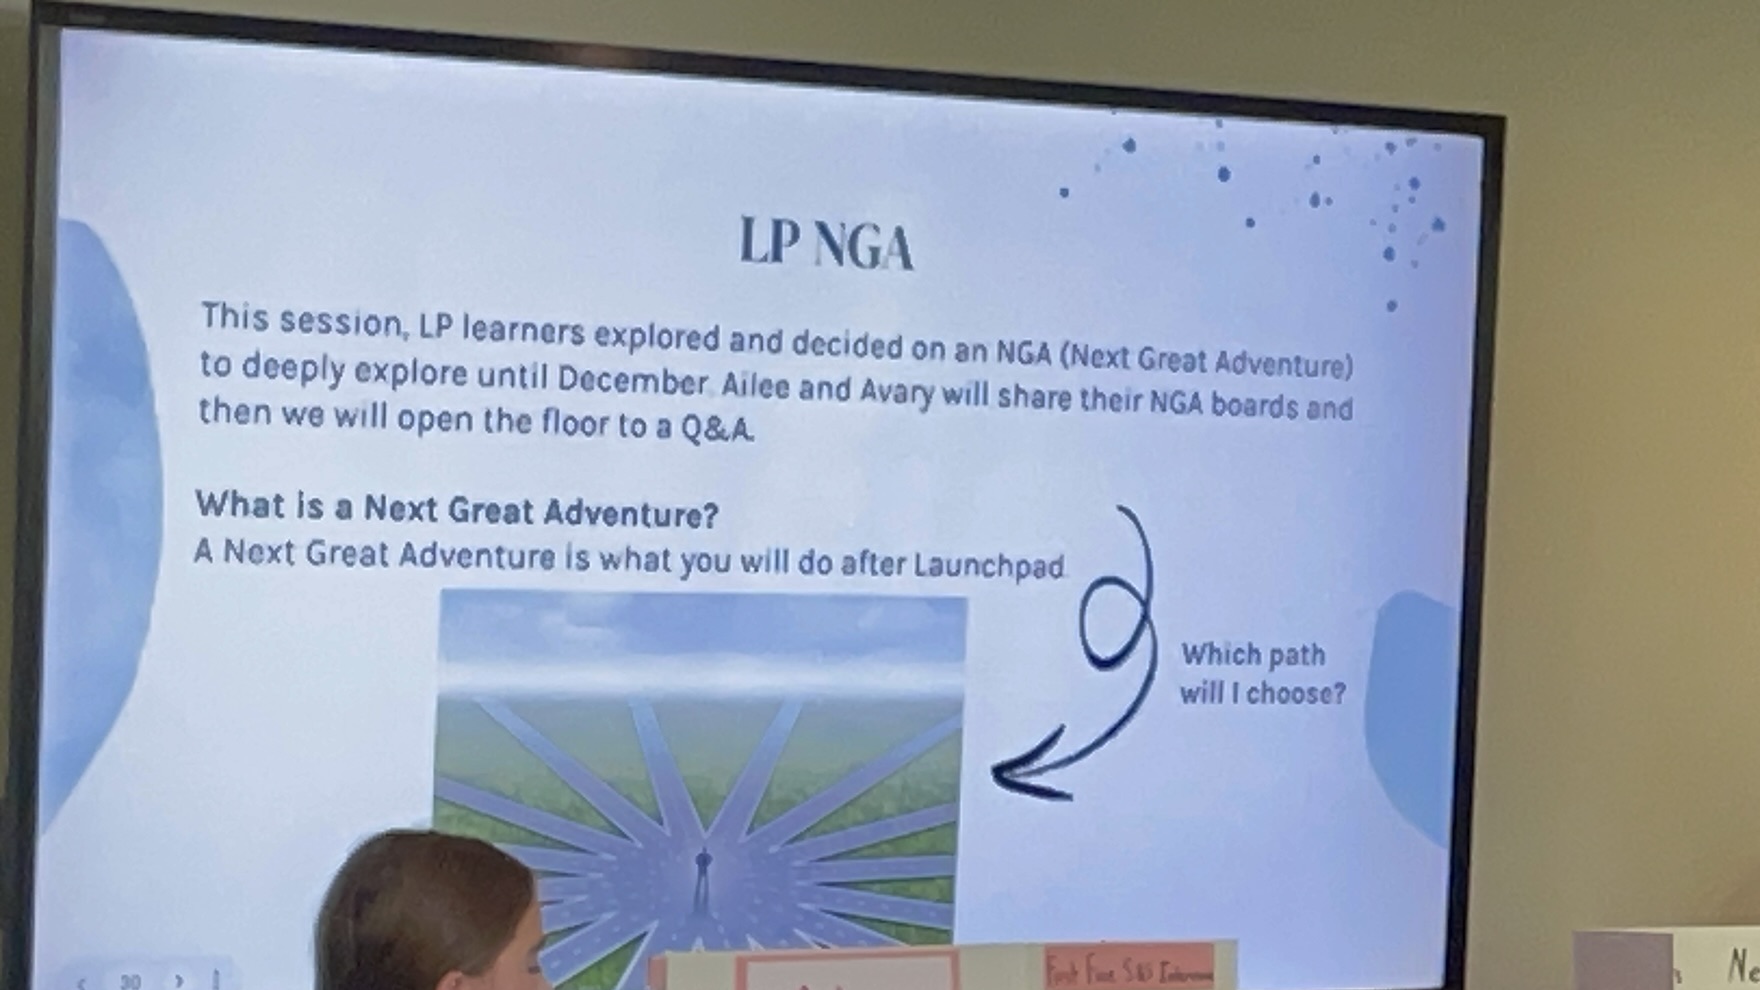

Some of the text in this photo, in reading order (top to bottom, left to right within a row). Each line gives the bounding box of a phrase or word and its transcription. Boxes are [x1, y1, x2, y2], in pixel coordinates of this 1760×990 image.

[740, 213, 916, 272] LP NGA
[200, 300, 1354, 382] This session, LP learners explored and decided on an NGA (Next Great Adventure)
[199, 349, 233, 379] to
[241, 348, 347, 392] deeply
[354, 356, 469, 393] explore
[476, 360, 549, 391] until
[720, 370, 791, 400] Ailee
[798, 374, 853, 403] and
[859, 376, 937, 415] Avary
[940, 379, 990, 408] will
[996, 382, 1073, 413] share
[1078, 384, 1145, 414] their
[1149, 389, 1205, 416] NGA
[1210, 389, 1300, 421] boards
[1306, 396, 1354, 422] and
[198, 393, 756, 448] then we will open the floor to a Q&A.
[193, 487, 721, 530] What is a Next Great Adventure?
[192, 536, 1065, 587] A Next Great Adventure is what you will do after Launchpad
[1180, 640, 1326, 674] Which path
[1178, 677, 1347, 706] will I choose?
[121, 974, 142, 990] 30
